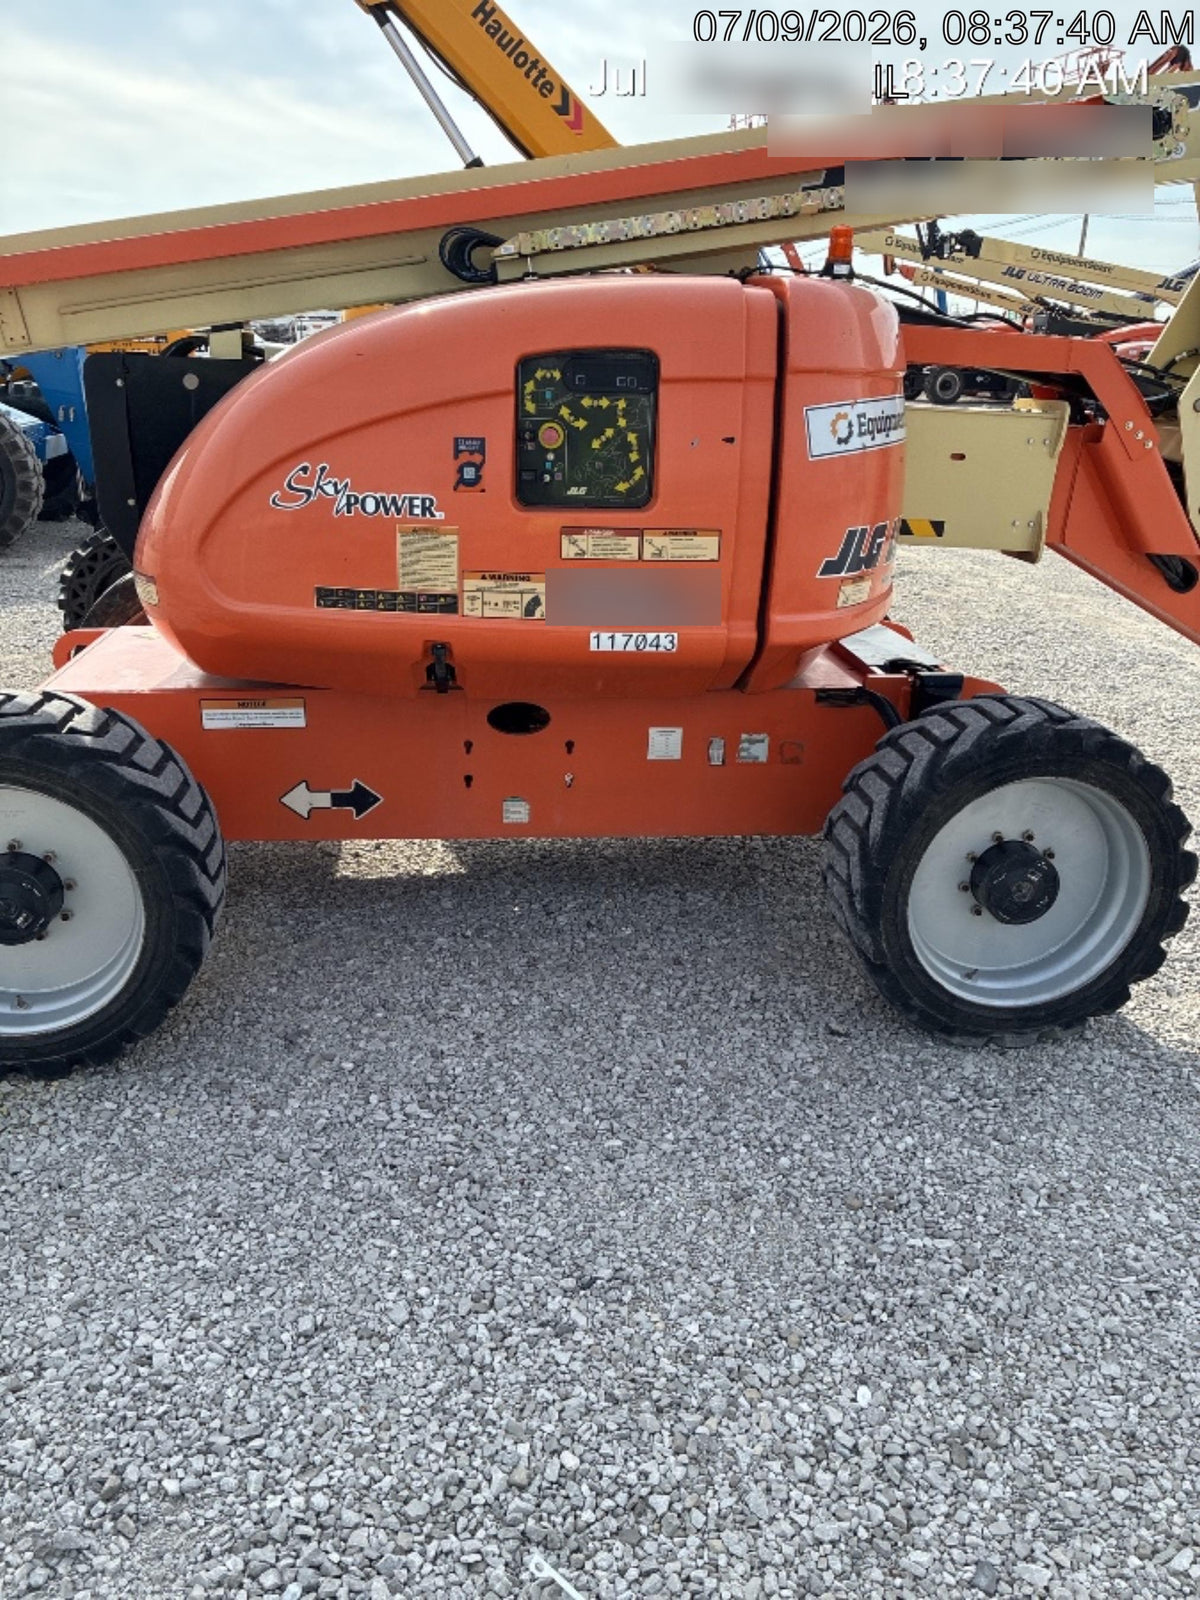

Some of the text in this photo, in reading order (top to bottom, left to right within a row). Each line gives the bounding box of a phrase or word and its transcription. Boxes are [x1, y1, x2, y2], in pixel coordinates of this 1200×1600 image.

[471, 0, 556, 99] Haulotte
[1000, 265, 1104, 300] JLG ULTRA BOOM
[1156, 277, 1187, 292] JLG
[566, 486, 588, 495] JLG
[816, 520, 889, 578] JLG
[489, 573, 532, 582] WARNING
[592, 633, 677, 652] 117043
